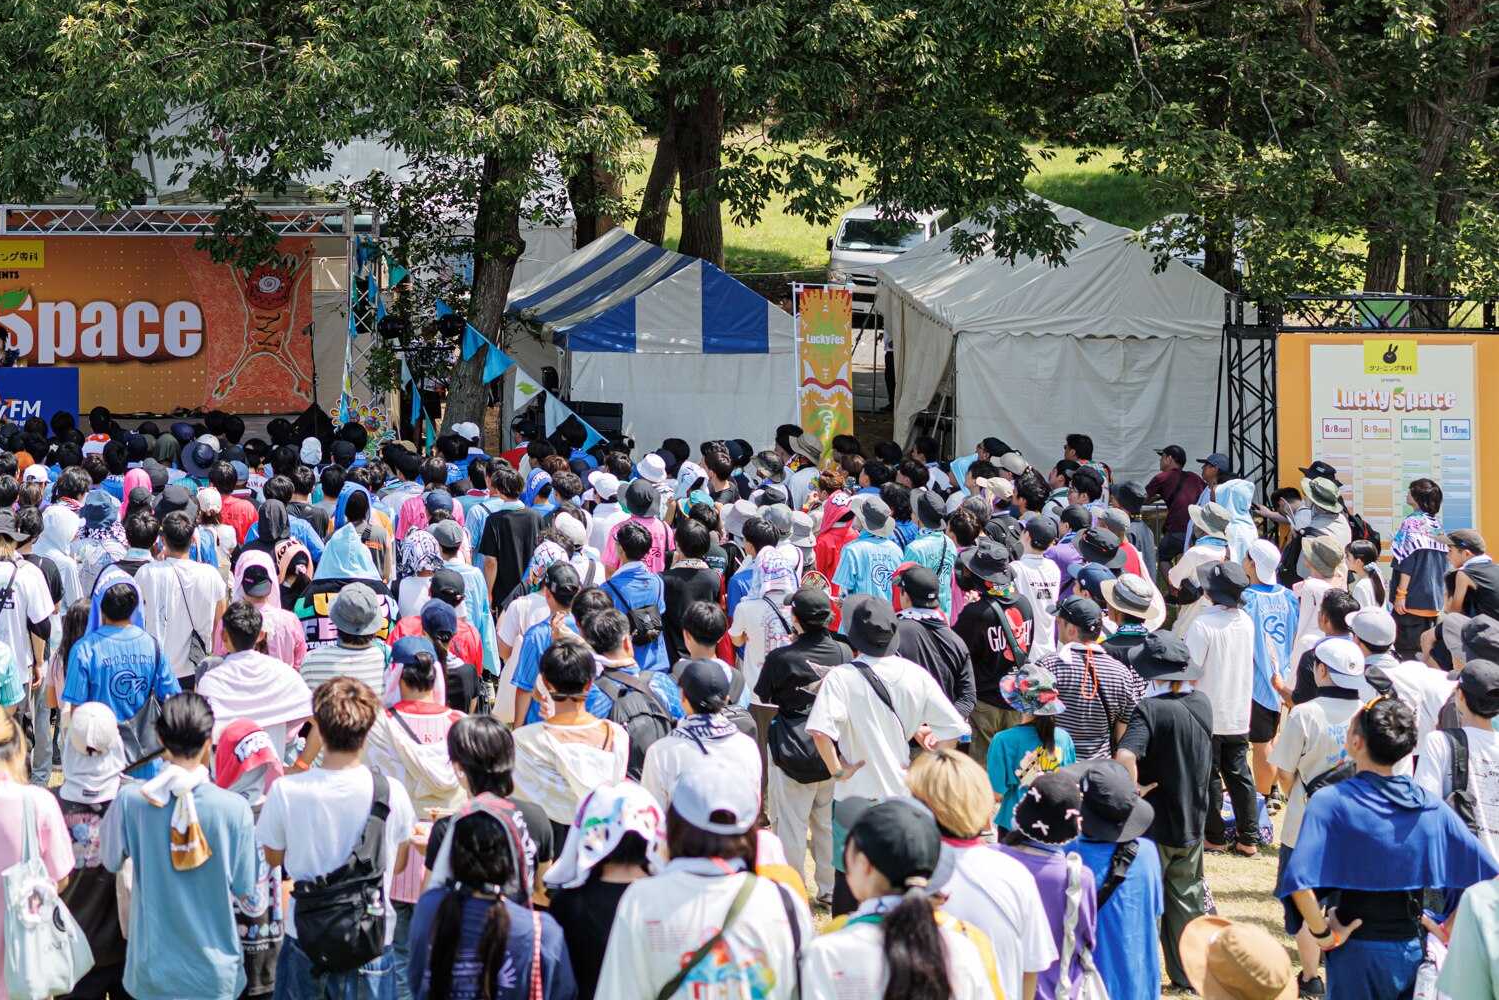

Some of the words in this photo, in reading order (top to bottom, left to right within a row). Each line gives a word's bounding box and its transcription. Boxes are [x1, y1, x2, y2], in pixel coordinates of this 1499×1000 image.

[806, 333, 845, 345] LuckyFes
[1332, 387, 1391, 411] Lucky
[1393, 387, 1457, 411] Space
